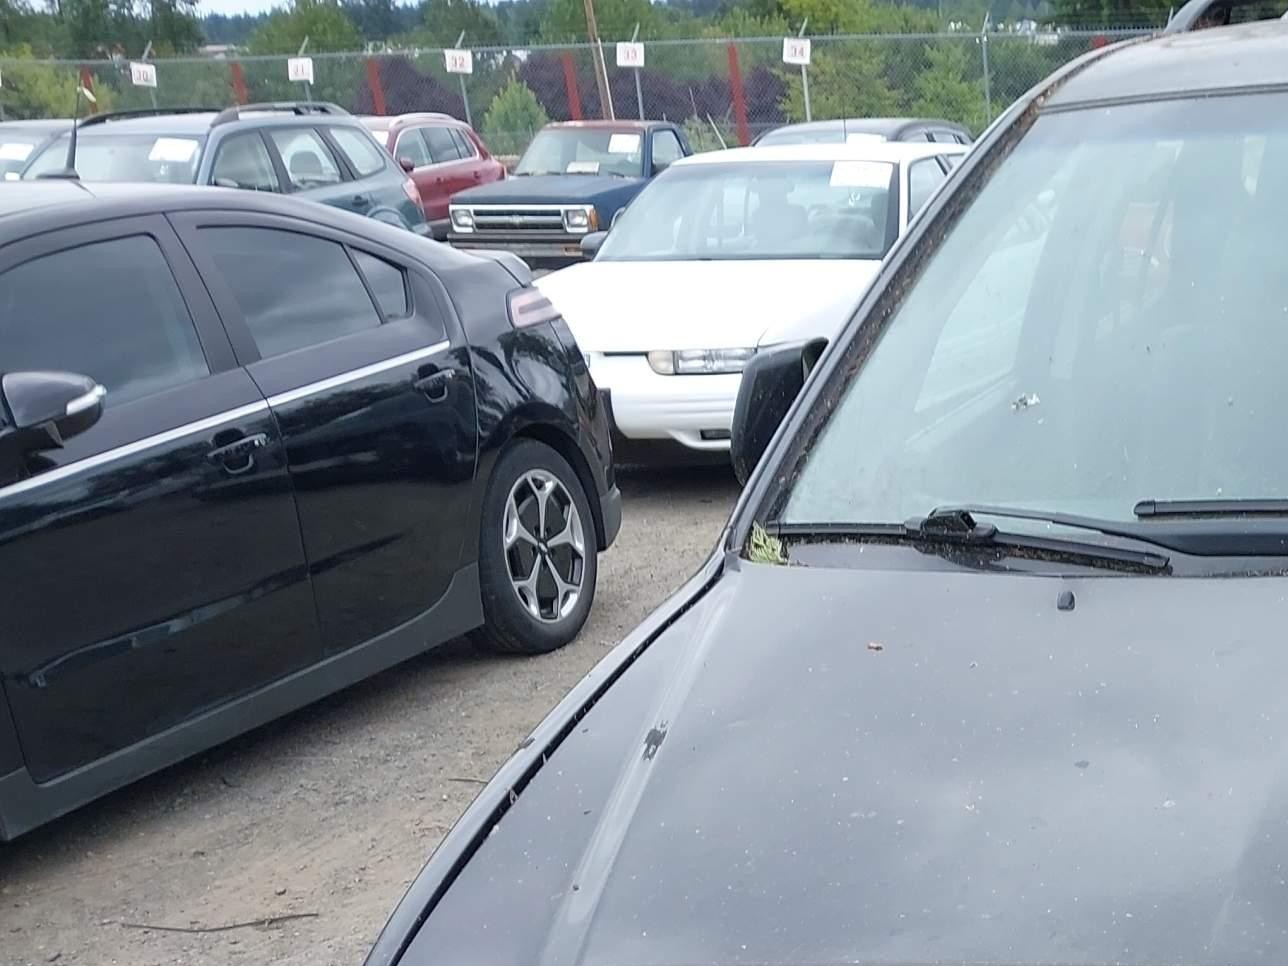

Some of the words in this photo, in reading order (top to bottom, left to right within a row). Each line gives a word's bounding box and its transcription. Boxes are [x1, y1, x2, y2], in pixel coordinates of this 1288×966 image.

[624, 48, 637, 60] 33
[791, 46, 805, 57] 34
[451, 55, 465, 67] 32
